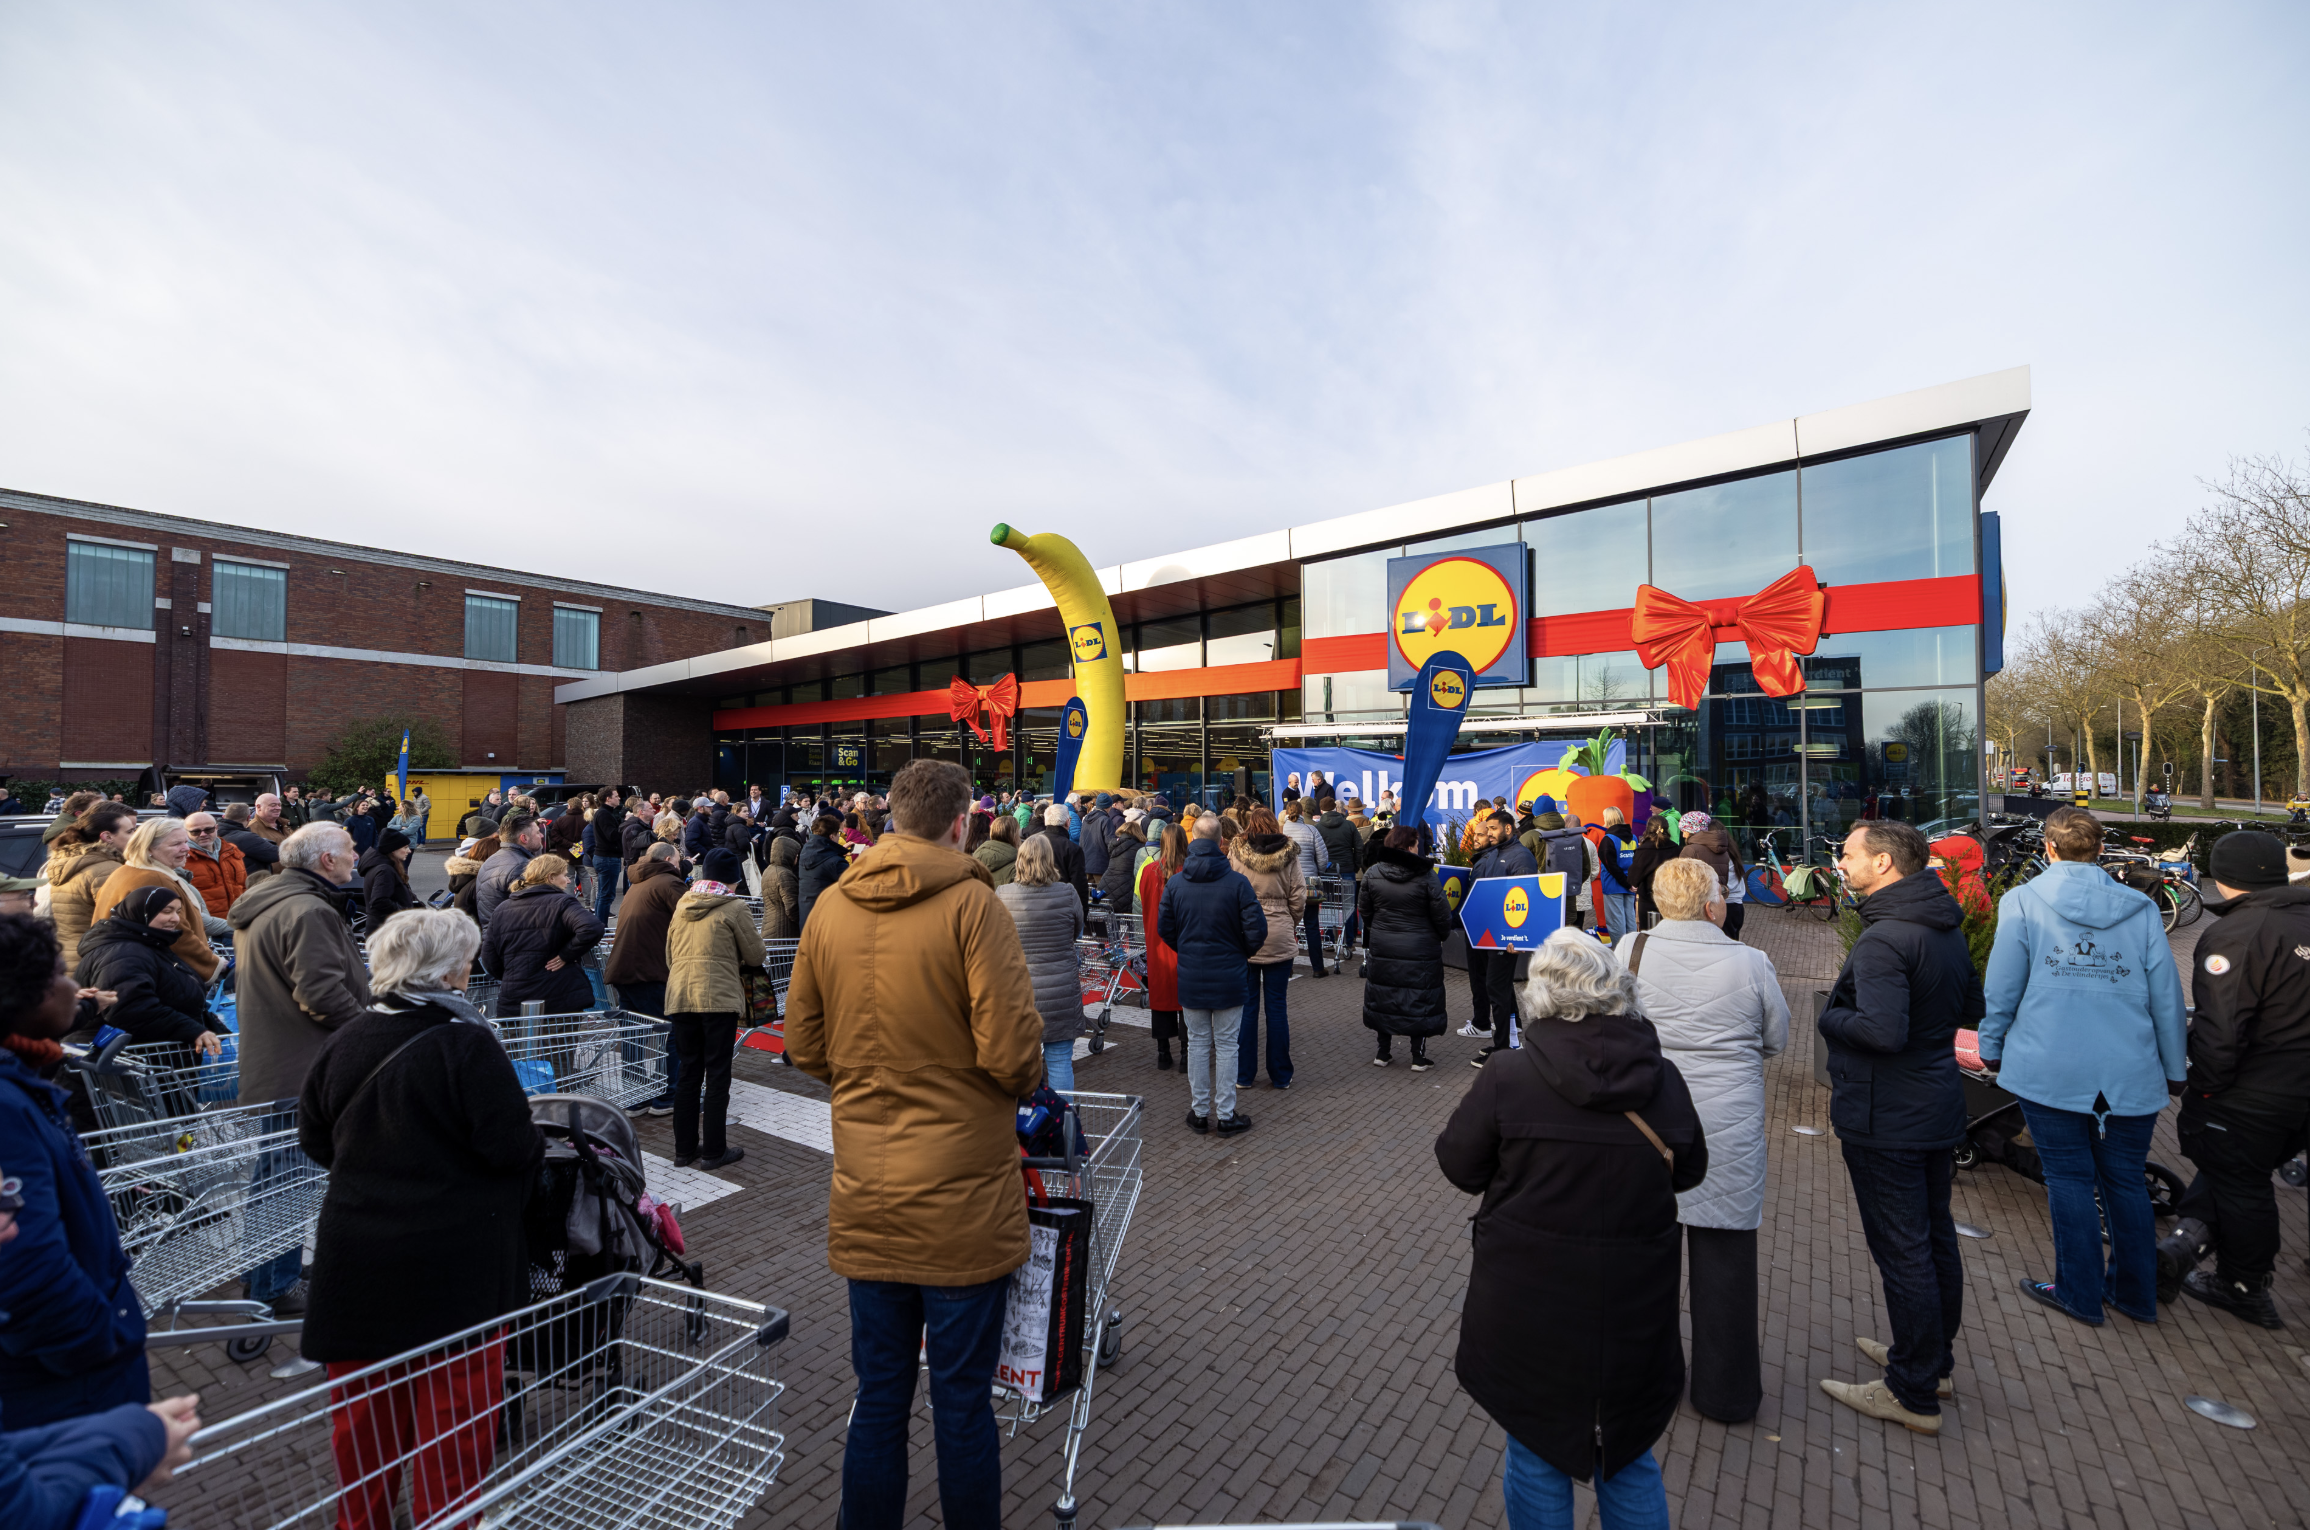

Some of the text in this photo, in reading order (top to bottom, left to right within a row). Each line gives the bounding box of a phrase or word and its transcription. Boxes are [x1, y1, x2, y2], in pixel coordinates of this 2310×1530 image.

[838, 747, 859, 757] Scan
[845, 757, 858, 767] Go
[783, 787, 788, 796] P
[2072, 971, 2109, 980] vlindertjes
